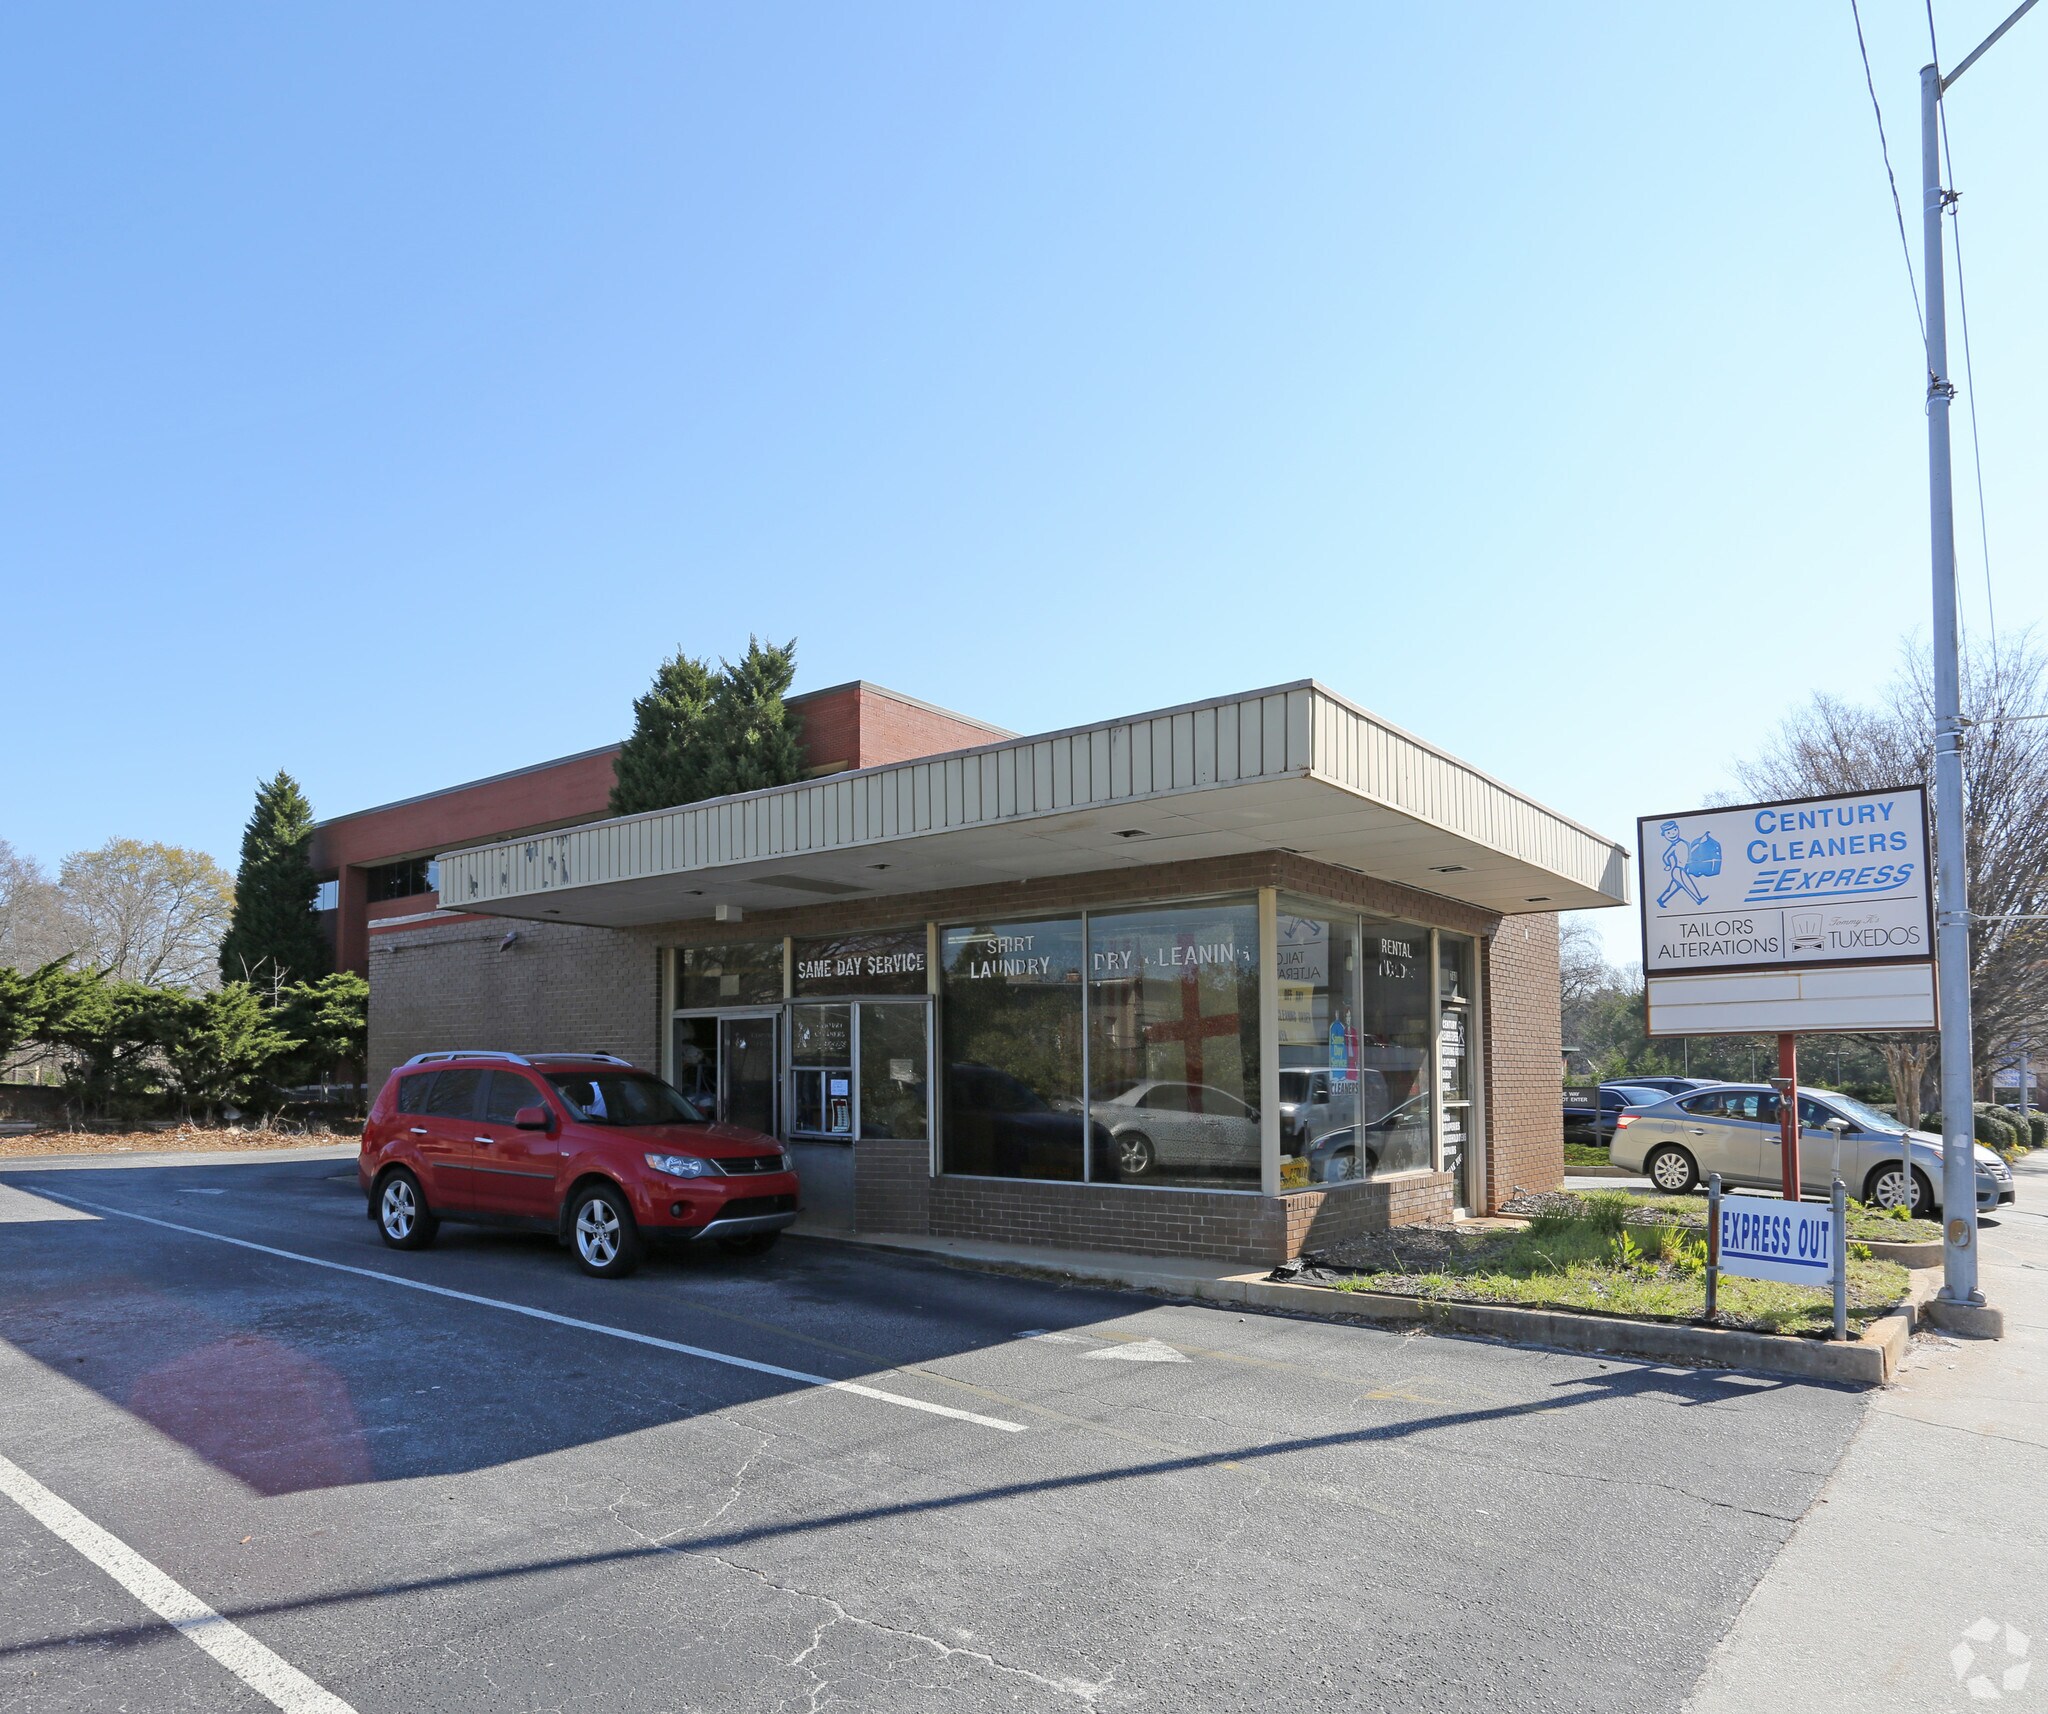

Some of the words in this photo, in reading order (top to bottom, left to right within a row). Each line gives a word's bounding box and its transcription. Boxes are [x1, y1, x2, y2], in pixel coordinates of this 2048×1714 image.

[1754, 802, 1894, 834] CENTURY
[1747, 831, 1907, 864] CLEANERS
[1773, 863, 1915, 892] EXPRESS
[1679, 919, 1754, 938] TAILORS
[1828, 916, 1862, 927] Tommy
[987, 935, 1035, 954] SHIRT
[1381, 938, 1413, 958] RENTAL
[1658, 937, 1779, 959] ALTERATIONS
[1828, 926, 1921, 949] TUXEDOS
[798, 959, 832, 979] SAME
[837, 957, 862, 976] DAY
[867, 952, 925, 976] SERVICE
[970, 956, 1050, 979] LAUNDRY
[1094, 950, 1132, 971] DRY
[1144, 942, 1250, 968] LEANIN
[1331, 1082, 1359, 1095] CLEANERS
[1722, 1211, 1791, 1256] EXPRESS
[1798, 1218, 1829, 1259] OUT
